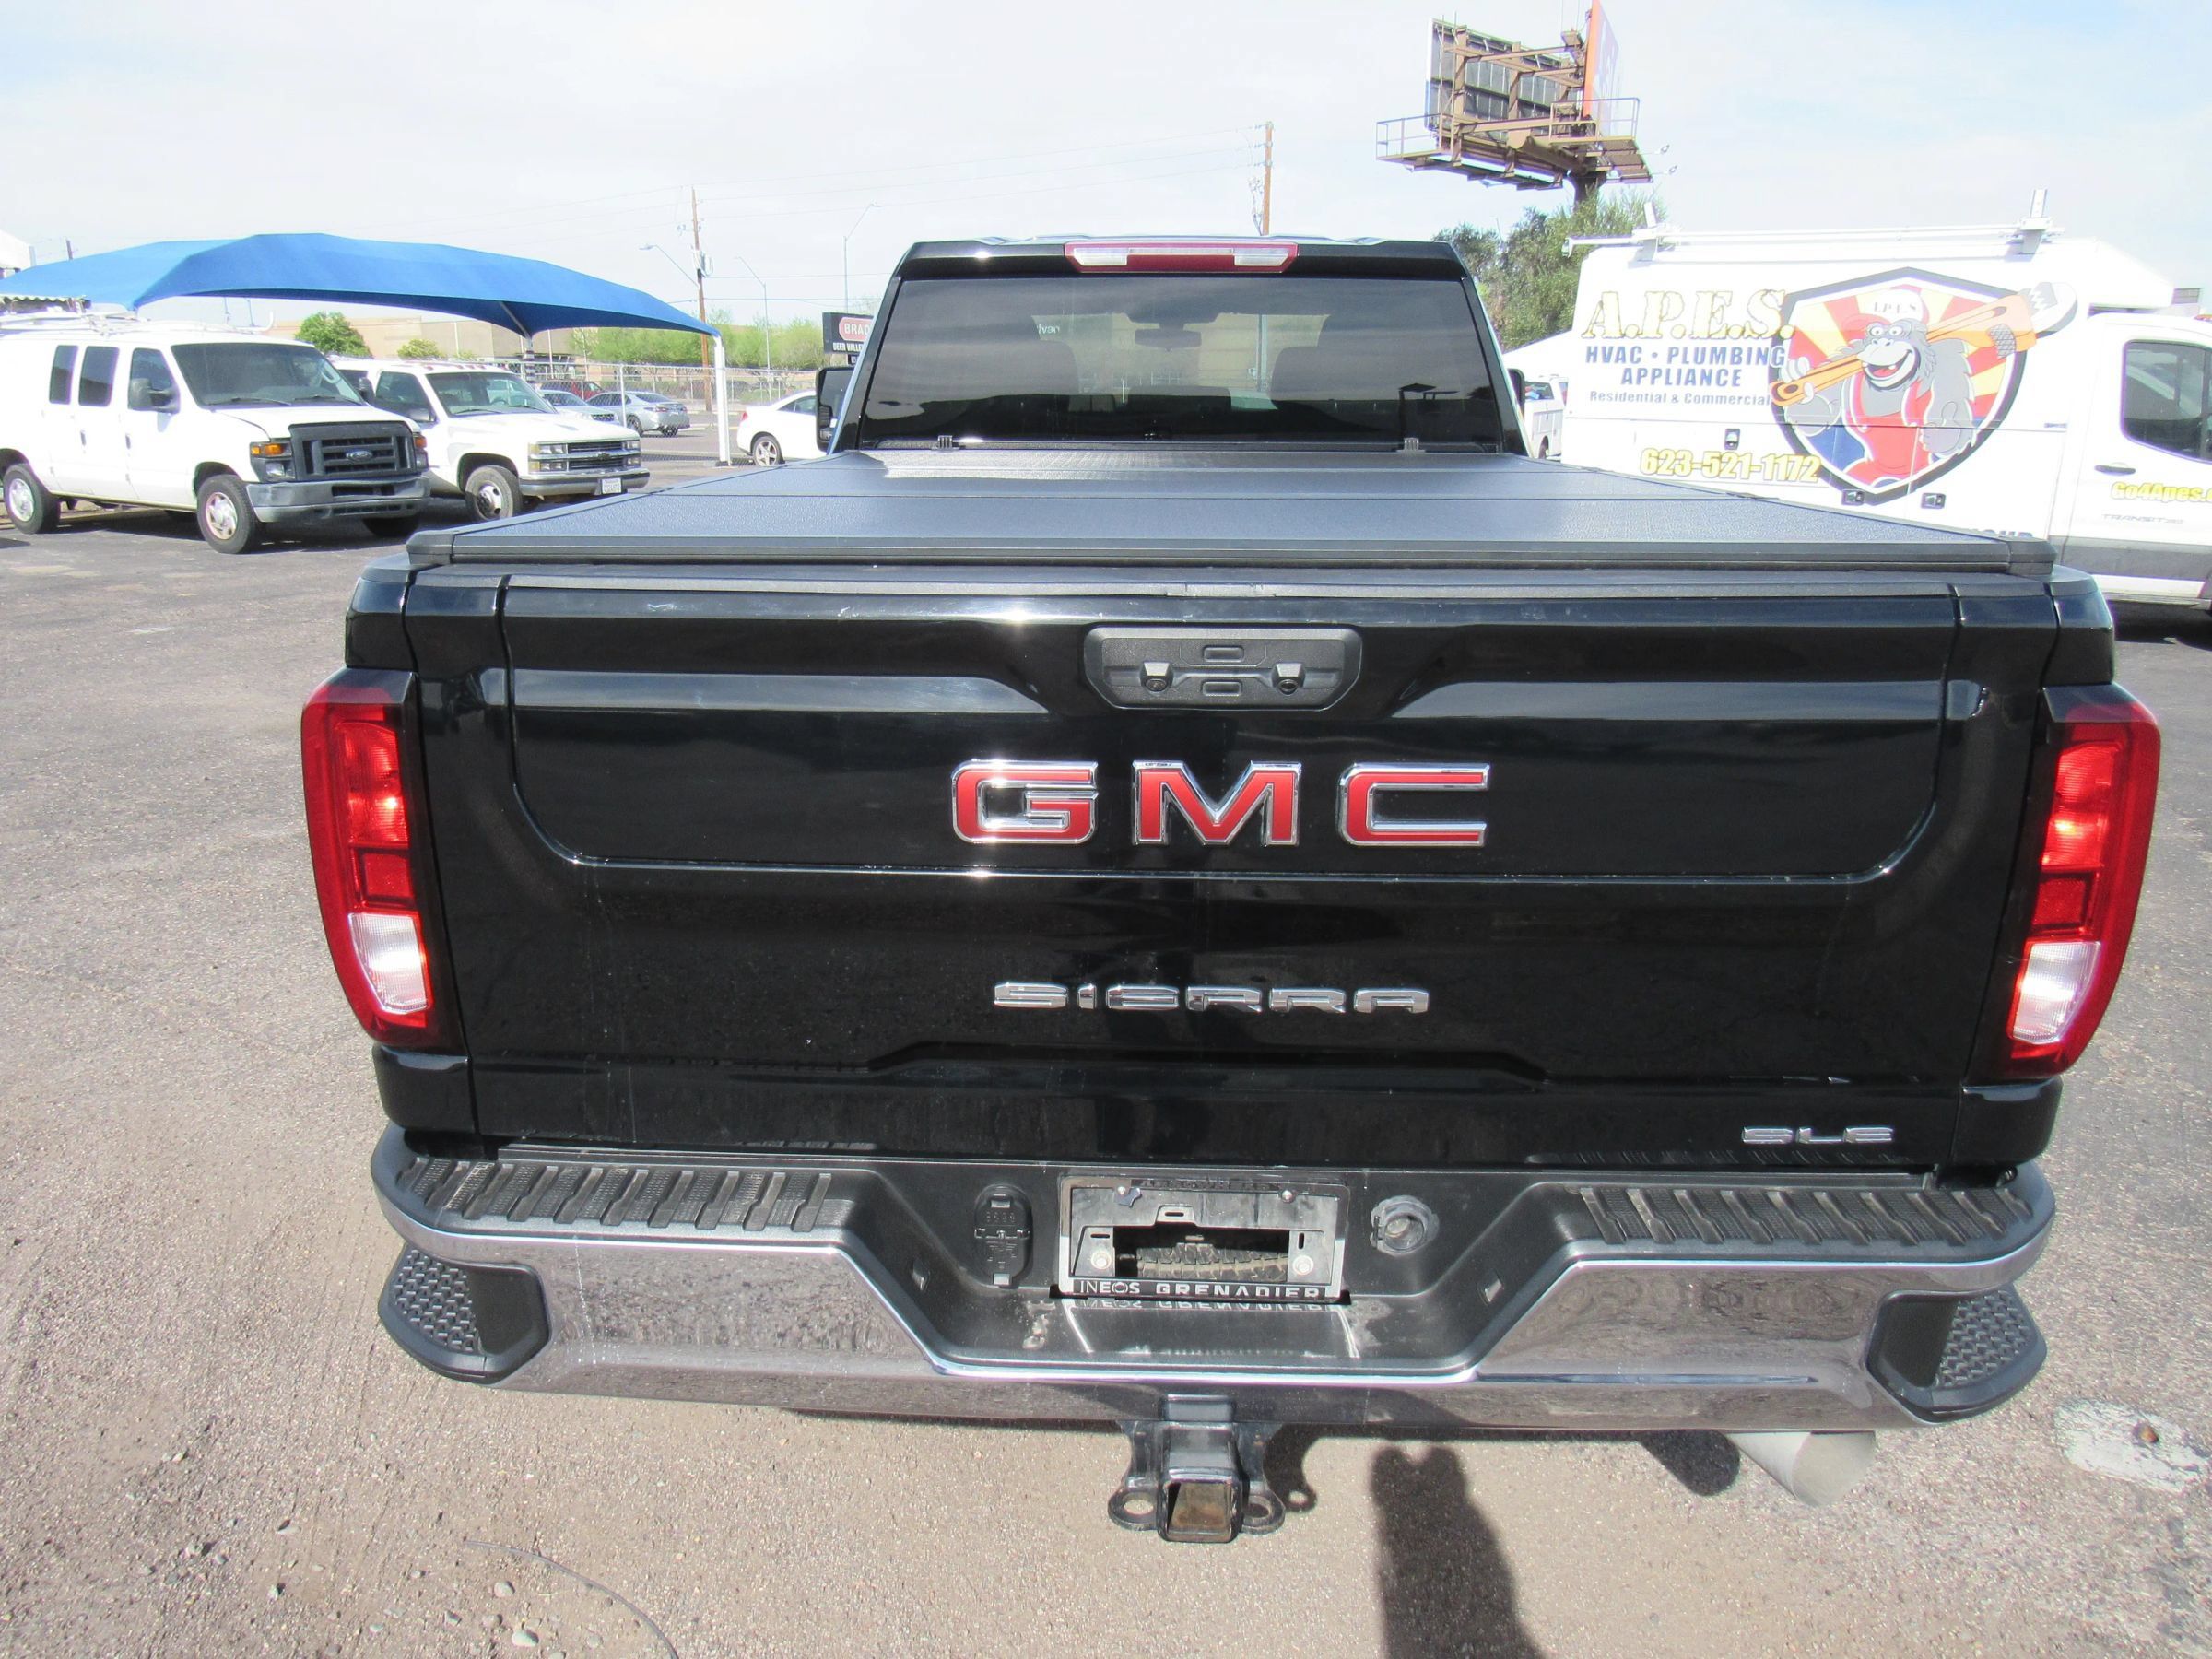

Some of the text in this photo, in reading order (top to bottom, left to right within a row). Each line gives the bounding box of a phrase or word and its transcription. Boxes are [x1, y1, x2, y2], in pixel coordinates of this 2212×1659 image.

[1581, 288, 1795, 340] A.P.E.S.
[1585, 346, 1786, 367] HVAC PLUMBING
[1620, 368, 1743, 387] APPLIANCE
[1589, 390, 1771, 406] Residential & Commercial
[1640, 447, 1823, 484] 623-521-1172
[950, 759, 1491, 848] GMC
[994, 982, 1430, 1015] SIERRA
[1741, 1126, 1894, 1145] SLE
[1079, 1279, 1321, 1298] INEOS GRENADIER
